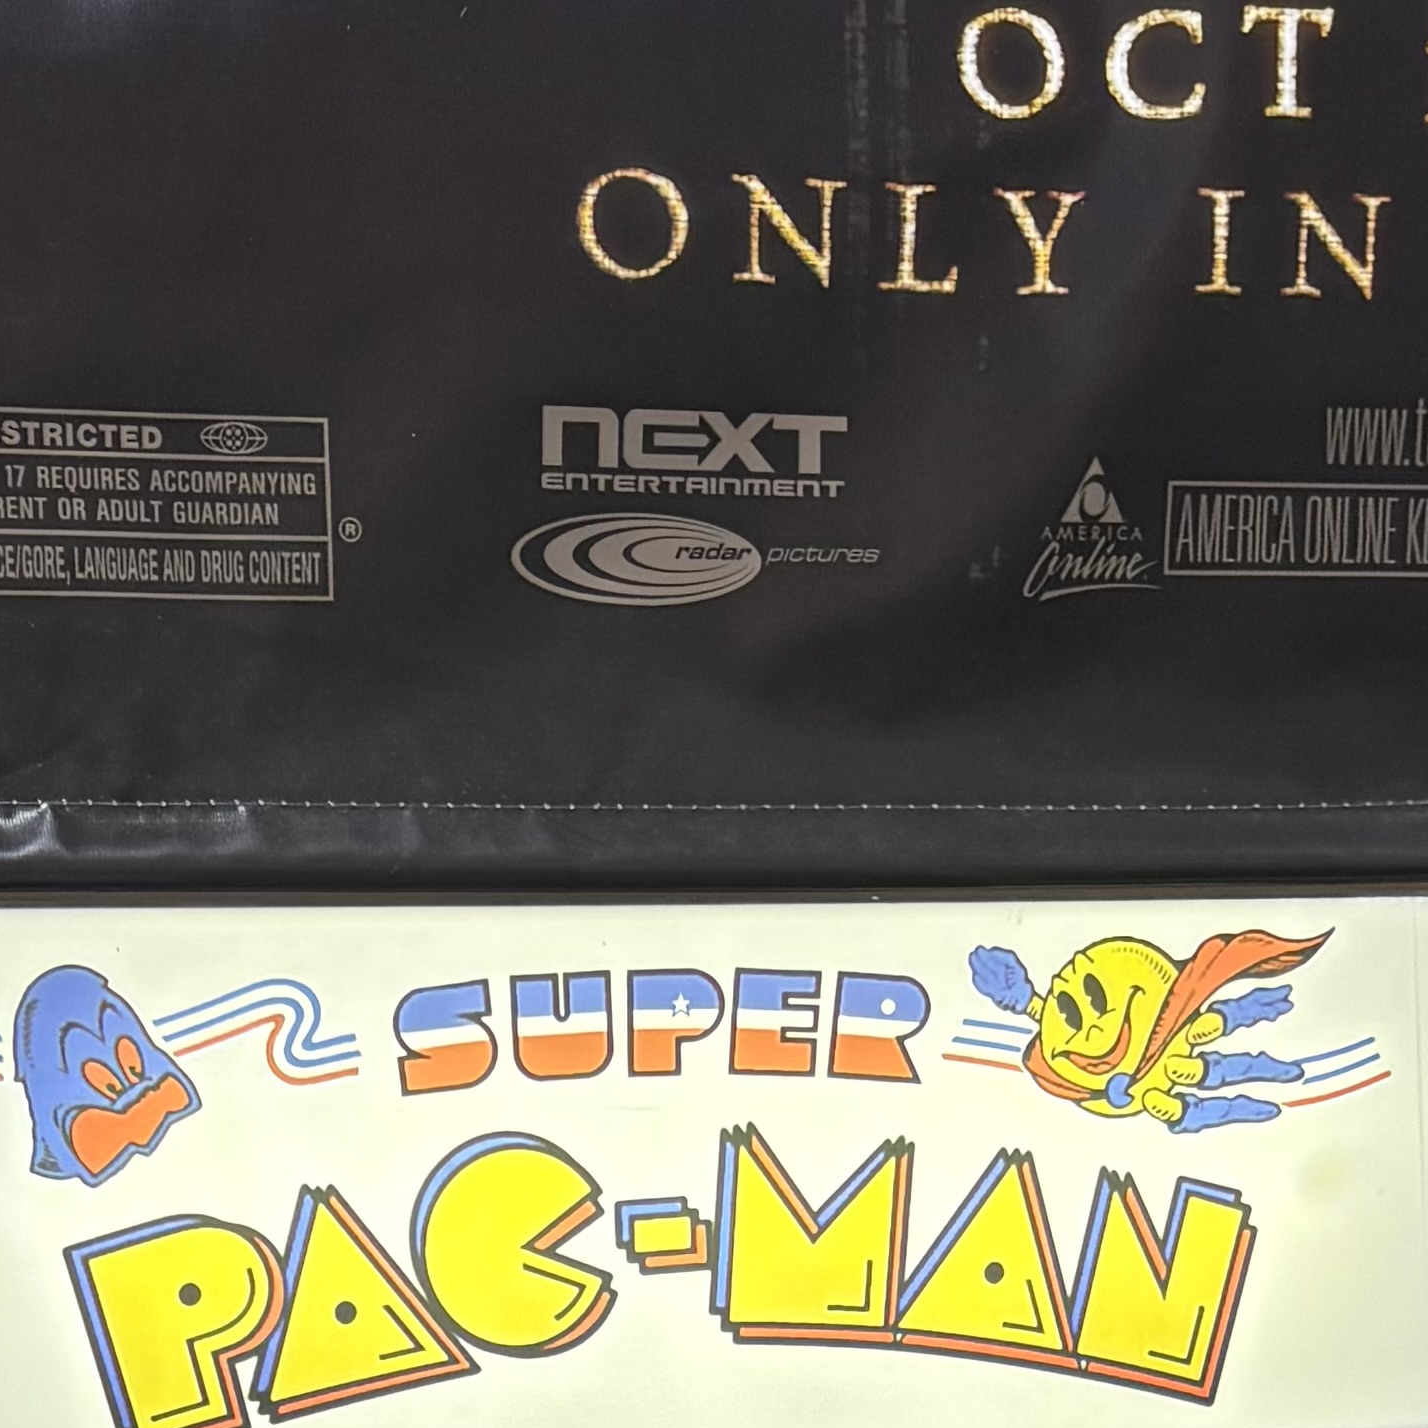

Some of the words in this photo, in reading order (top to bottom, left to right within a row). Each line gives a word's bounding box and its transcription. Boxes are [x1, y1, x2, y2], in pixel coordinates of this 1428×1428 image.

[956, 4, 1335, 120] OCT
[575, 166, 1086, 296] ONLY
[1194, 187, 1393, 301] IN
[539, 404, 849, 475] NEXT
[3, 464, 27, 489] 17
[36, 466, 141, 494] REQUIRES
[148, 468, 318, 497] ACCOMPANYING
[539, 472, 846, 499] ENTERTAINMENT
[56, 496, 87, 521] OR
[95, 498, 163, 524] ADULT
[172, 499, 281, 526] GUARDIAN
[1175, 494, 1295, 566] AMERICA
[1303, 494, 1397, 566] ONLINE
[1039, 524, 1144, 543] AMERICA
[74, 546, 159, 583] LANGUAGE
[162, 547, 197, 584] AND
[200, 548, 246, 585] DRUG
[248, 549, 323, 586] CONTENT
[674, 541, 752, 565] radar
[765, 545, 881, 568] pictures
[394, 965, 933, 1098] SUPER
